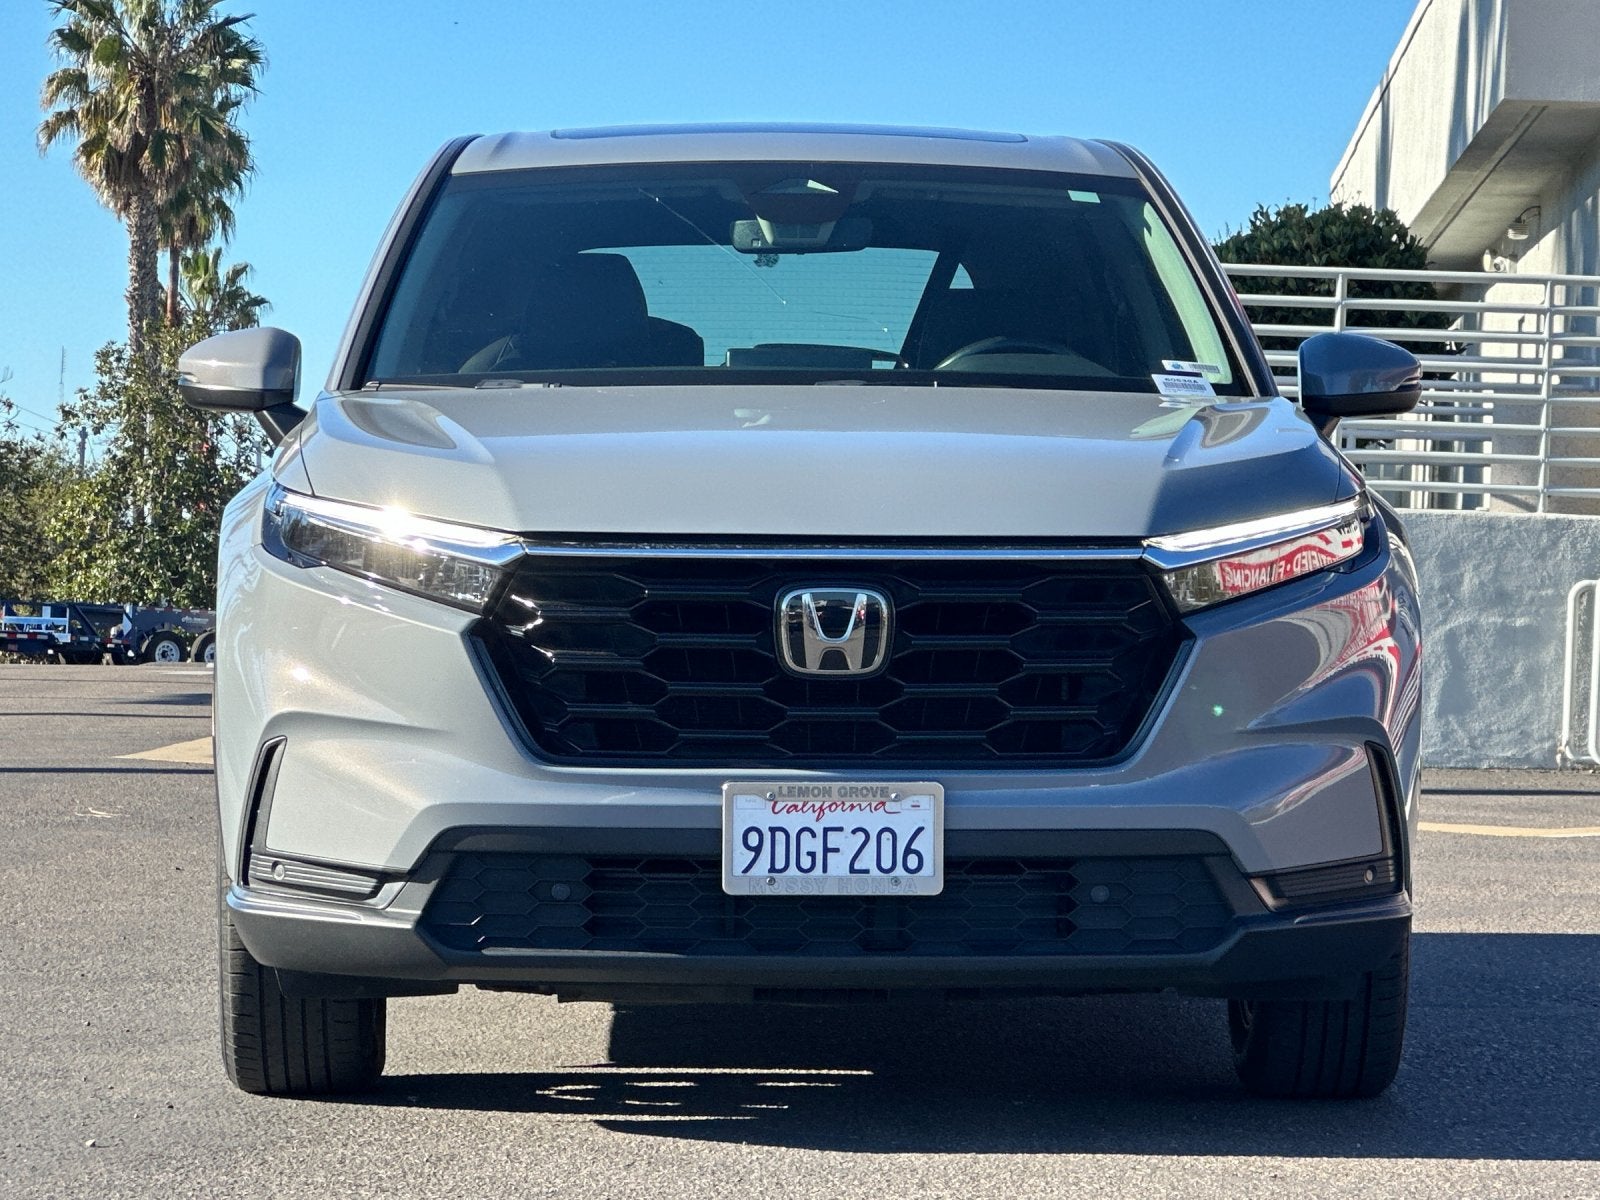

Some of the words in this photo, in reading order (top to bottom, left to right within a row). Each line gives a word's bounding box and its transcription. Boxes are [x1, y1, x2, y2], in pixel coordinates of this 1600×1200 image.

[778, 786, 833, 798] LEMON
[837, 786, 890, 798] GROVE
[771, 800, 901, 822] California
[741, 826, 925, 874] 9DGF206
